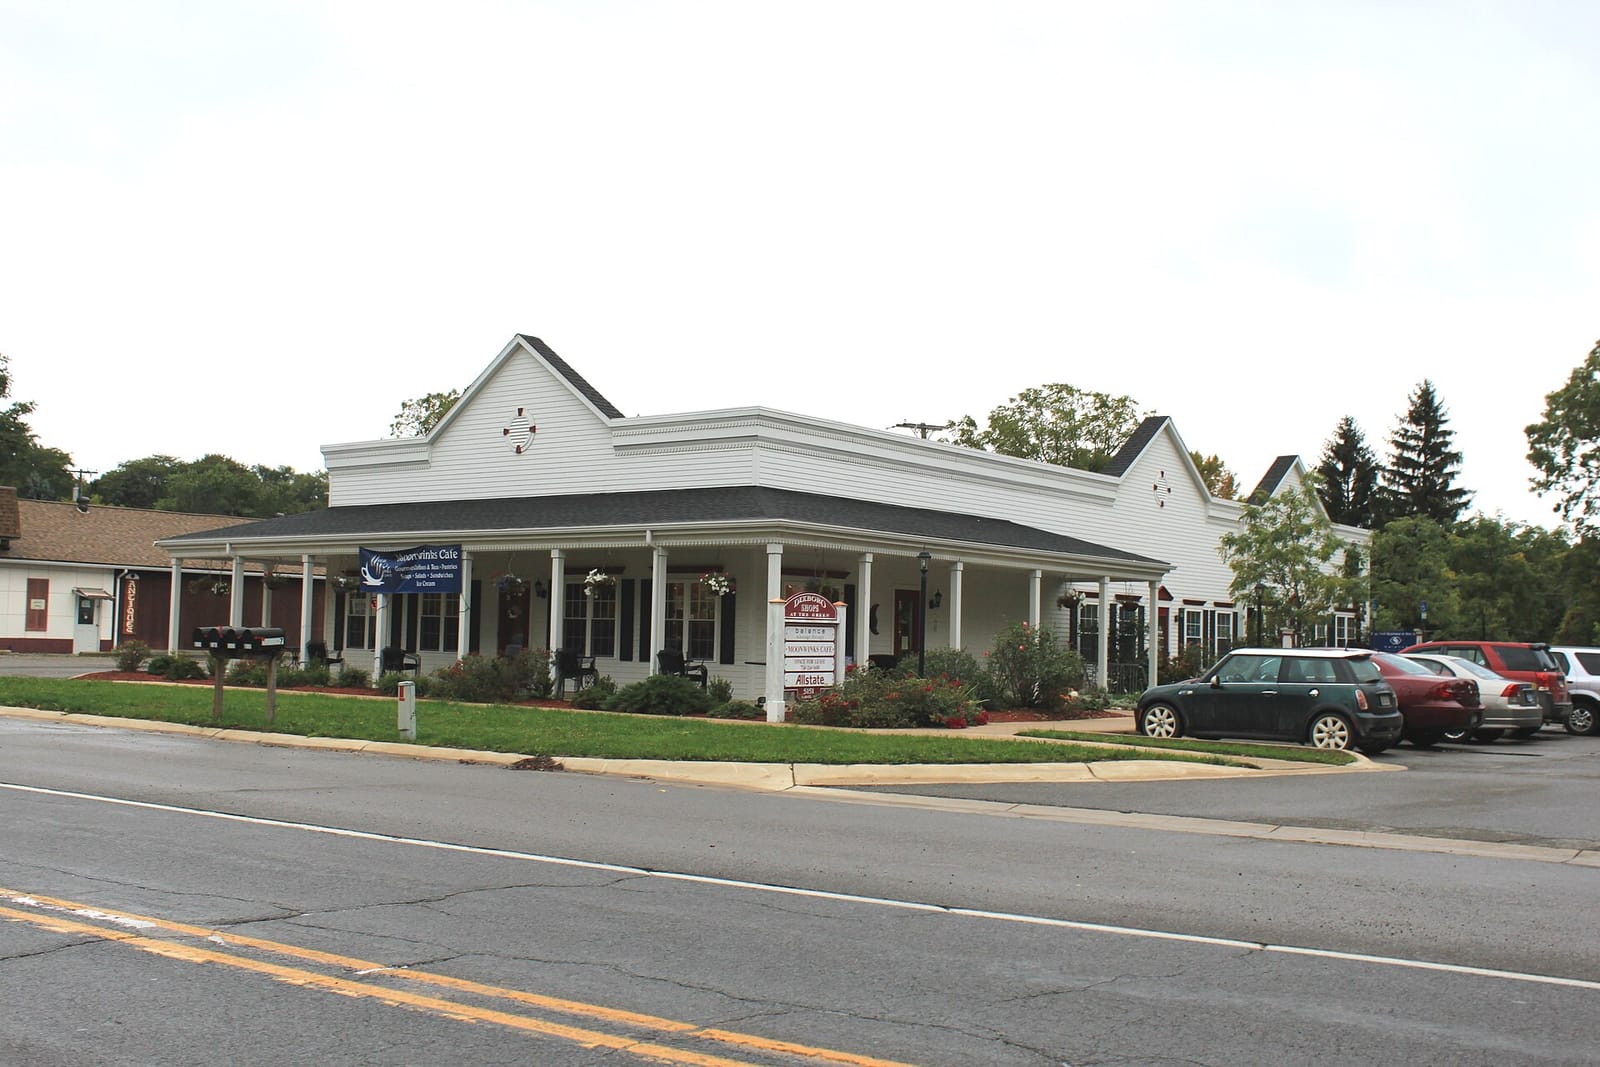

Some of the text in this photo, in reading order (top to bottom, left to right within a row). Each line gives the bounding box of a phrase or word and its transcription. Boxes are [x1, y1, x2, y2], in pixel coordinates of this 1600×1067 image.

[439, 549, 458, 560] Cafe
[801, 604, 819, 612] SHOPS
[796, 674, 825, 685] Allstate
